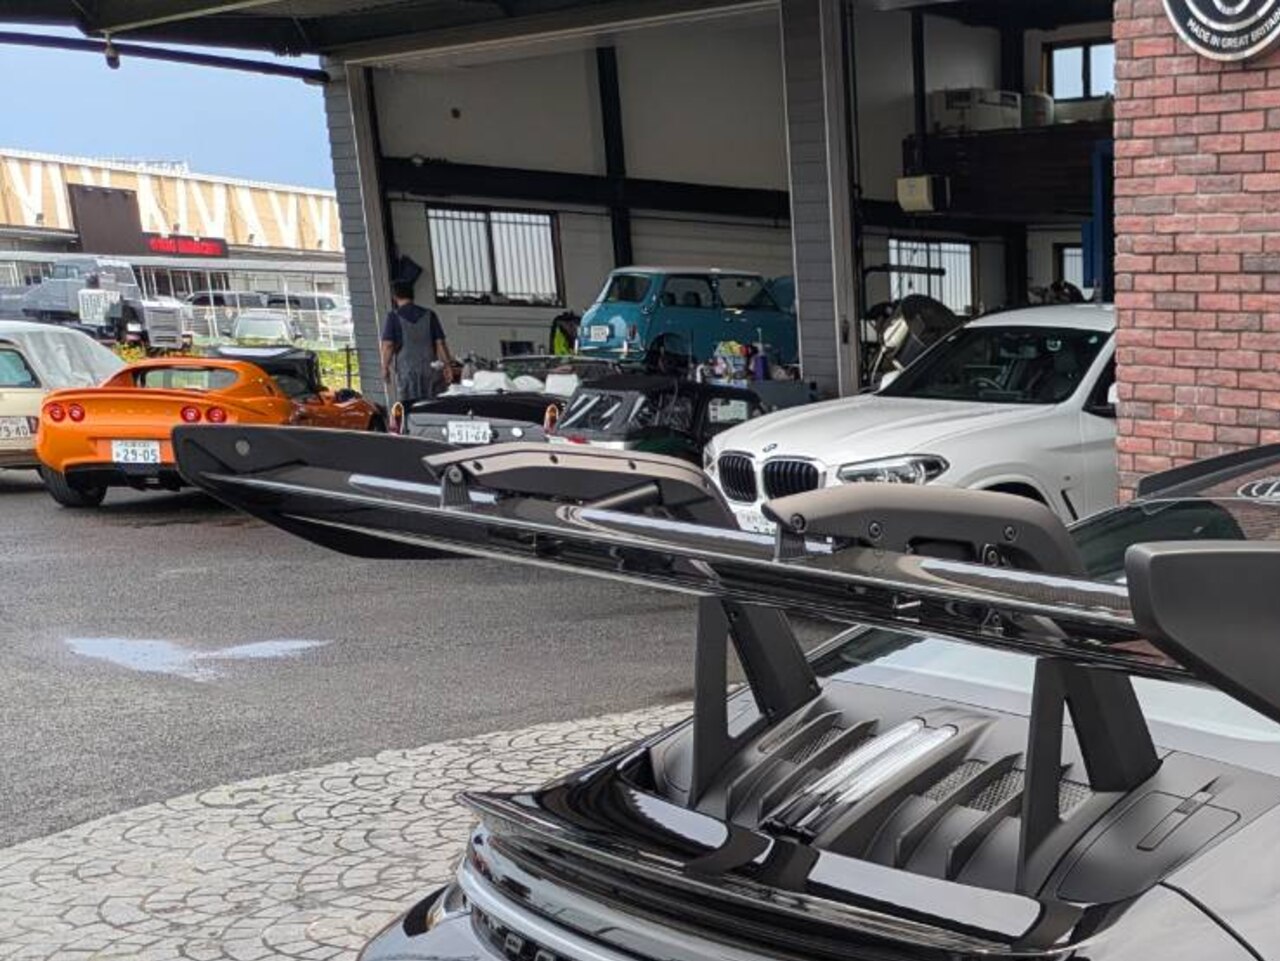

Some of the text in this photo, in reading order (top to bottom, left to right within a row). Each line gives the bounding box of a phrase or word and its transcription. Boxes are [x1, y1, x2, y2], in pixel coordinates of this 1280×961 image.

[1187, 18, 1211, 43] MADE
[1209, 35, 1220, 47] IN
[1221, 34, 1249, 48] GREAT
